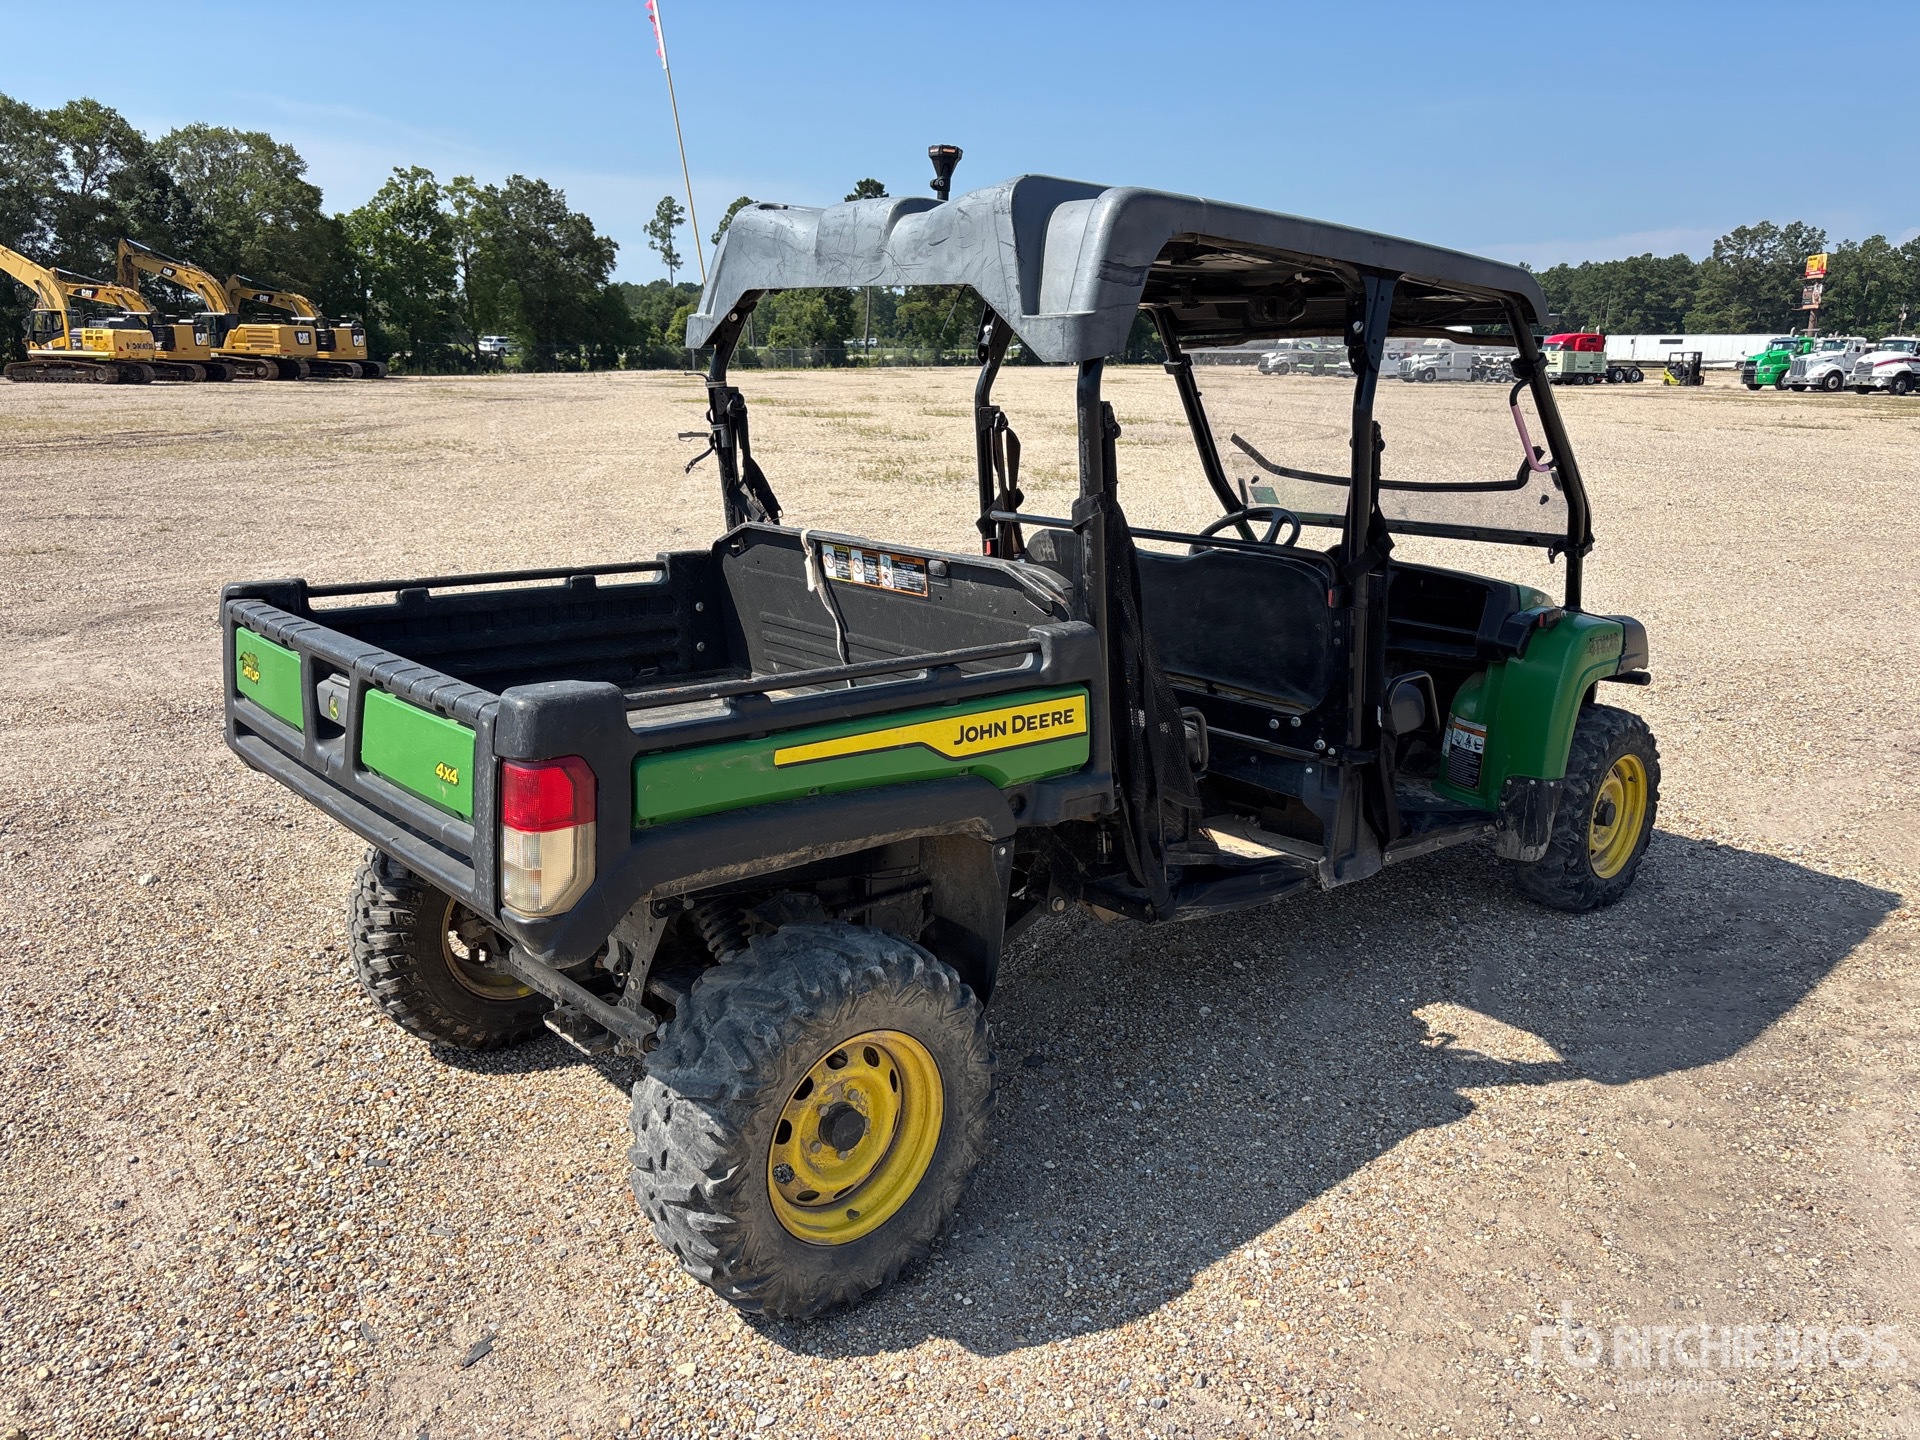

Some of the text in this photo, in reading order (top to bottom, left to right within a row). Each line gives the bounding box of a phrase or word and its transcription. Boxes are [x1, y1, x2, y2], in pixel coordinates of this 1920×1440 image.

[81, 288, 93, 298] CAT
[259, 294, 270, 303] CAT
[195, 332, 208, 346] CAT
[297, 332, 310, 344] CAT
[353, 335, 365, 347] CAT
[953, 708, 1075, 746] JOHN DEERE
